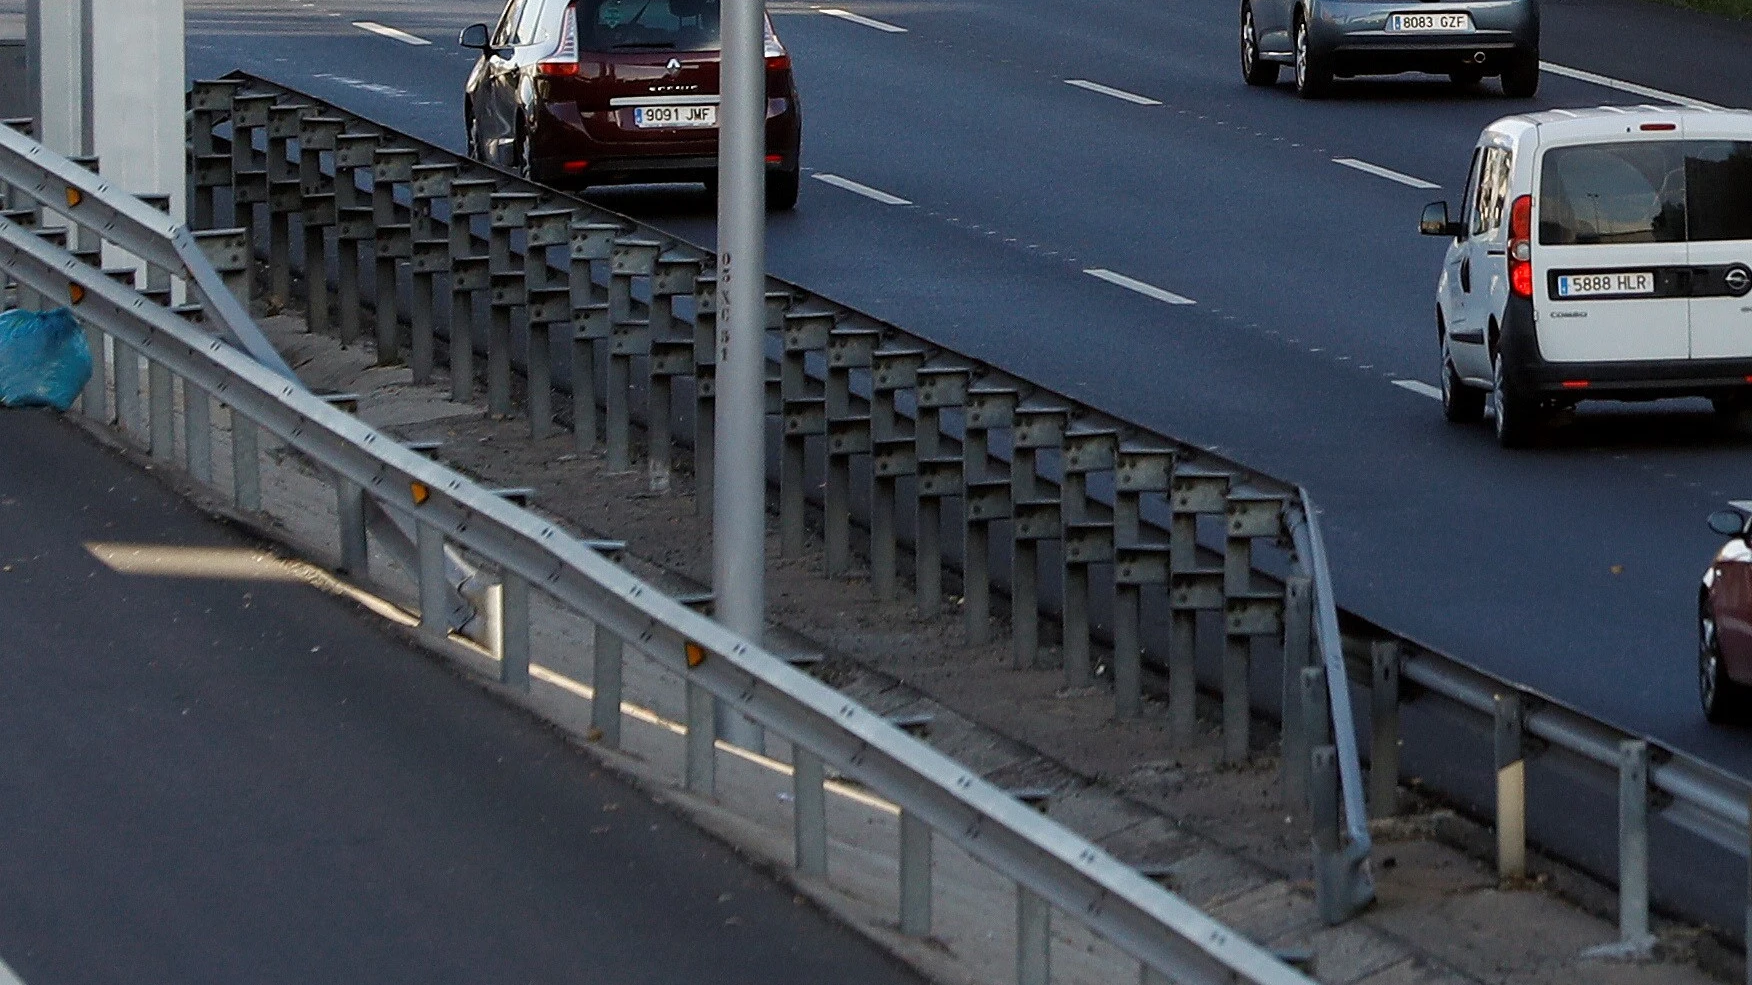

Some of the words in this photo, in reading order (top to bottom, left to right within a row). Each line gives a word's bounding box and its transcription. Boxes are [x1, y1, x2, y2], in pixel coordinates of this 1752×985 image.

[1403, 16, 1434, 29] 8083
[1440, 16, 1465, 28] GZF
[645, 107, 680, 122] 9091
[685, 107, 710, 121] JMF
[1572, 276, 1612, 293] 5888
[1617, 274, 1647, 291] HLR
